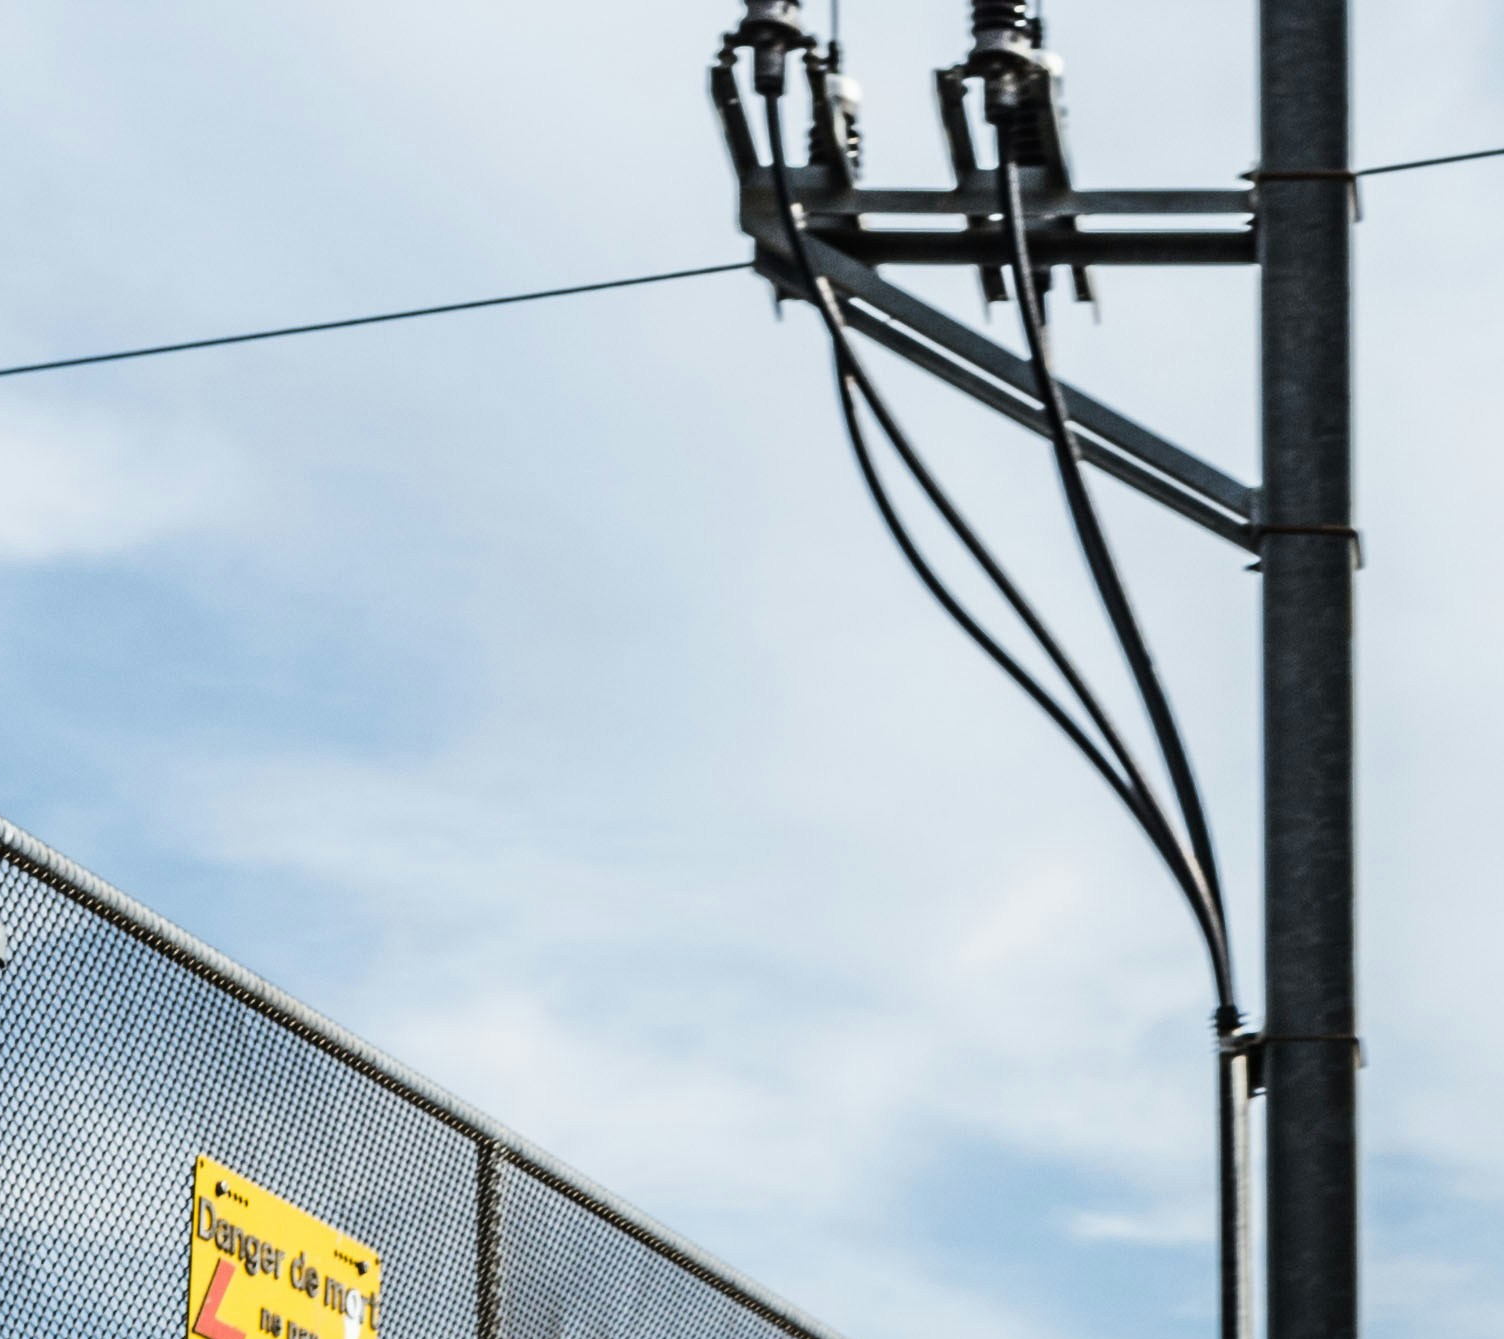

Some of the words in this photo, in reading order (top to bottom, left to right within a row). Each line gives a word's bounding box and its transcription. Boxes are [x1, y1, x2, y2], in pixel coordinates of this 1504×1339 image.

[197, 1196, 284, 1280] Danger
[291, 1251, 319, 1298] de
[324, 1276, 379, 1331] mort
[260, 1308, 282, 1337] ne
